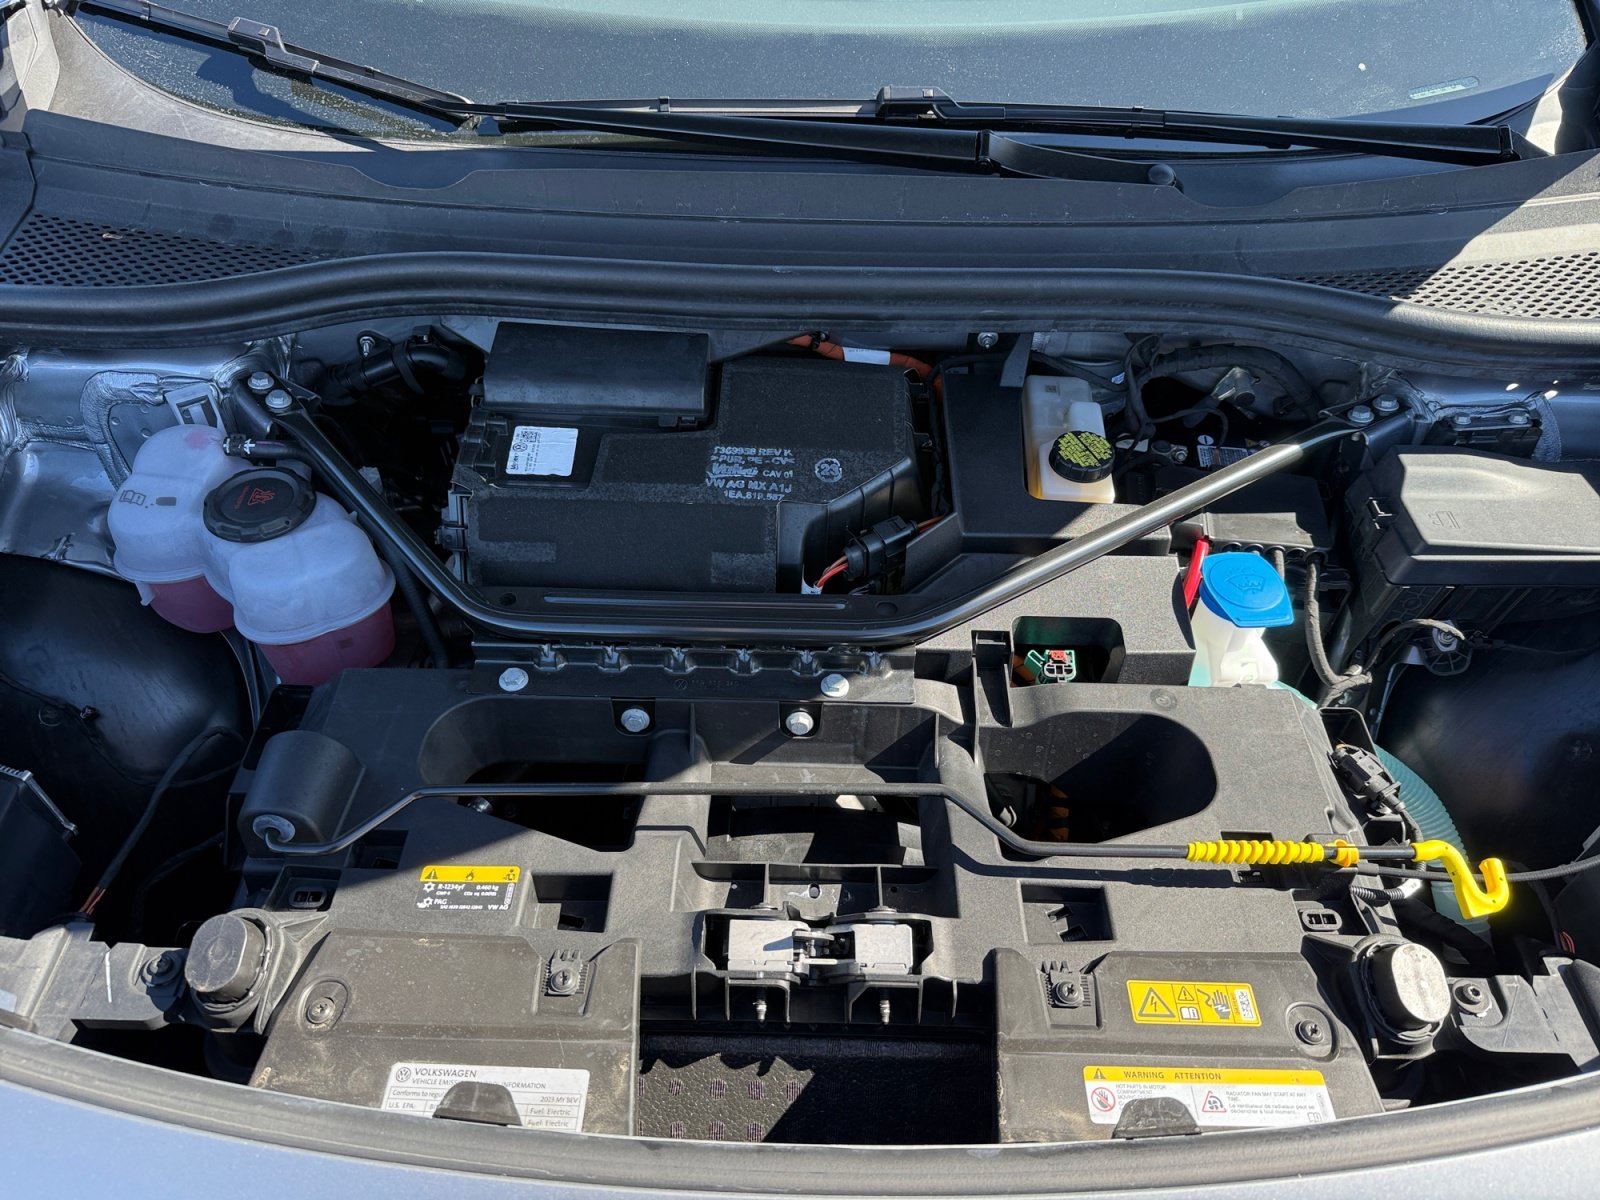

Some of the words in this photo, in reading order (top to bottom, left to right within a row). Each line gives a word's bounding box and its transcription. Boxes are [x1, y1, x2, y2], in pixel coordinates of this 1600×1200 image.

[758, 448, 782, 456] REV
[784, 449, 793, 457] K
[763, 470, 782, 478] CAV
[705, 478, 726, 488] VW
[726, 480, 745, 489] AG
[747, 481, 767, 490] MX
[415, 1068, 477, 1077] VOLKSWAGEN
[1123, 1071, 1164, 1079] WARNING
[1174, 1072, 1221, 1080] ATTENTION
